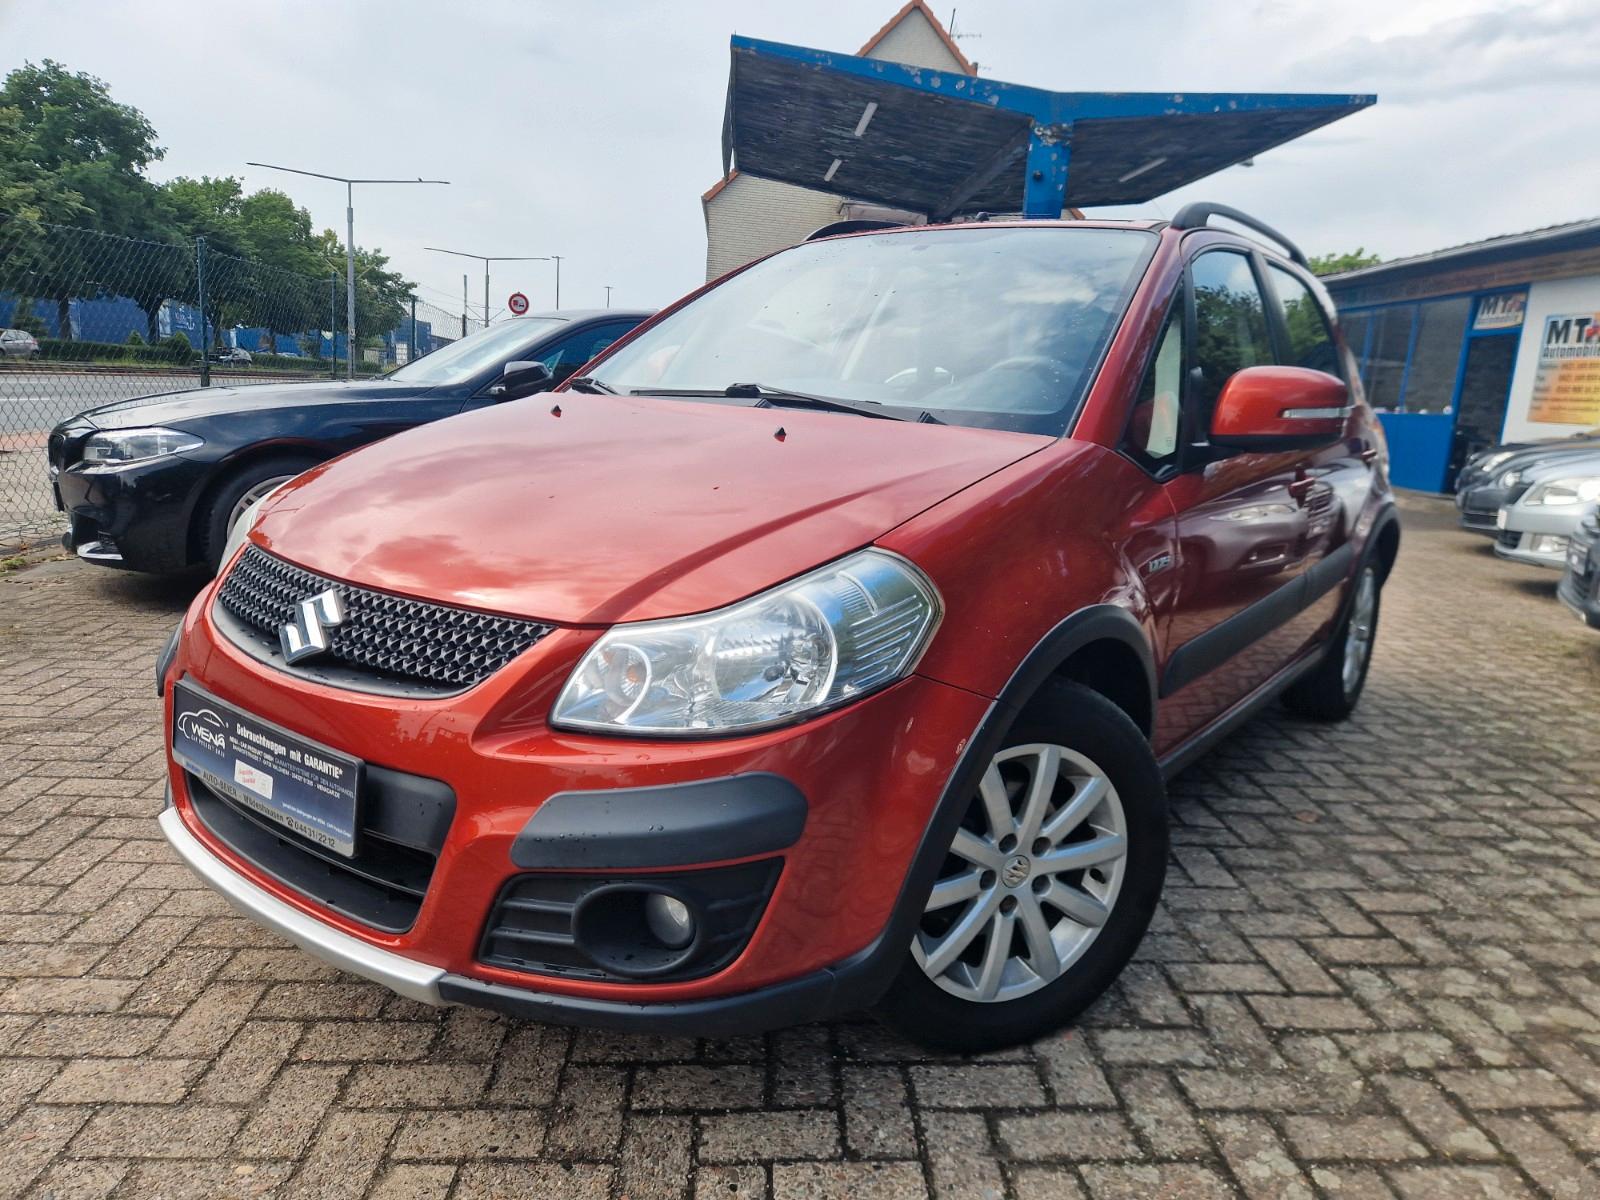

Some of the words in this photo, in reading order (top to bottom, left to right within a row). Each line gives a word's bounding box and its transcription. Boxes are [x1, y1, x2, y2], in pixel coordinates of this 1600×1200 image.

[191, 721, 226, 750] WENA
[236, 722, 286, 756] Gebrauchtwagen
[289, 749, 302, 763] mit
